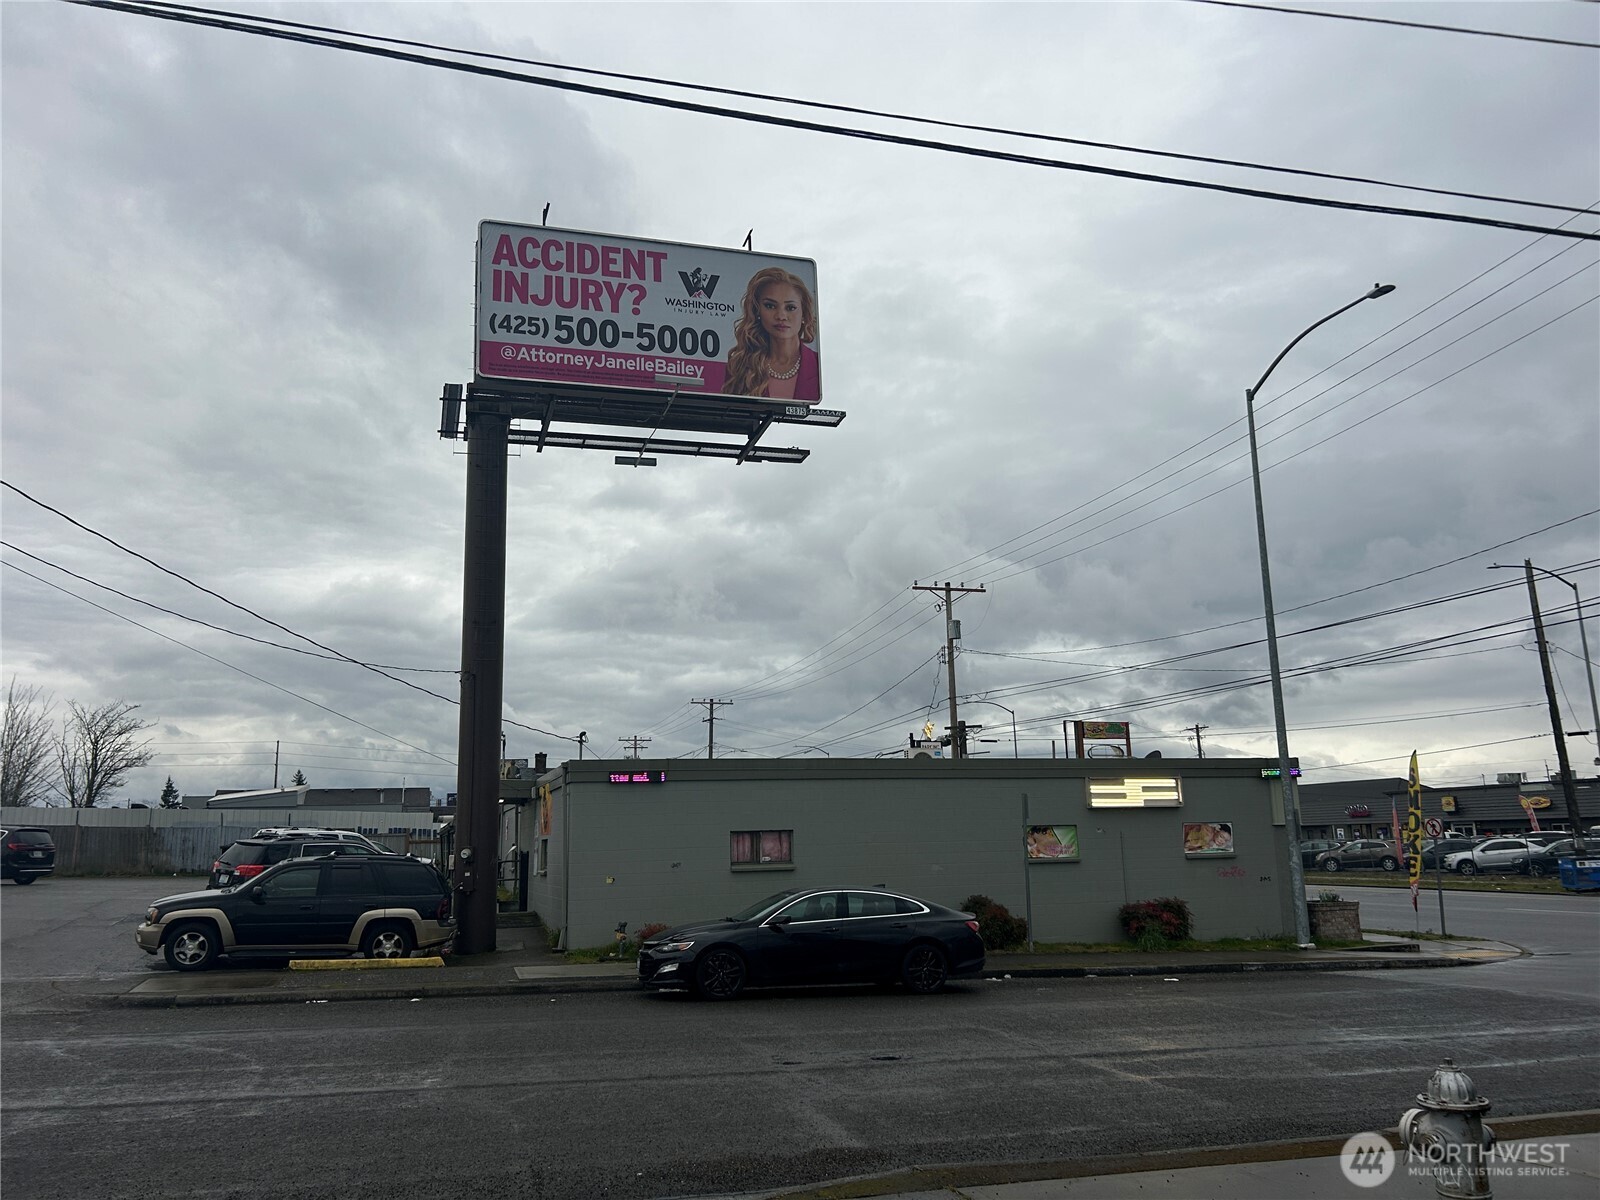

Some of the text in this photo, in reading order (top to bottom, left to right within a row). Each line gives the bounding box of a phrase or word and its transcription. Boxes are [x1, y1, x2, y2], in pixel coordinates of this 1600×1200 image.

[491, 233, 668, 283] ACCIDENT
[492, 269, 648, 316] INJURY?
[664, 296, 735, 313] WASHINGTON
[673, 307, 705, 316] INJURY
[489, 312, 721, 358] (425) 500-5000
[500, 345, 705, 379] @AttorneyJanelleBailey
[1408, 767, 1421, 878] SMOKE
